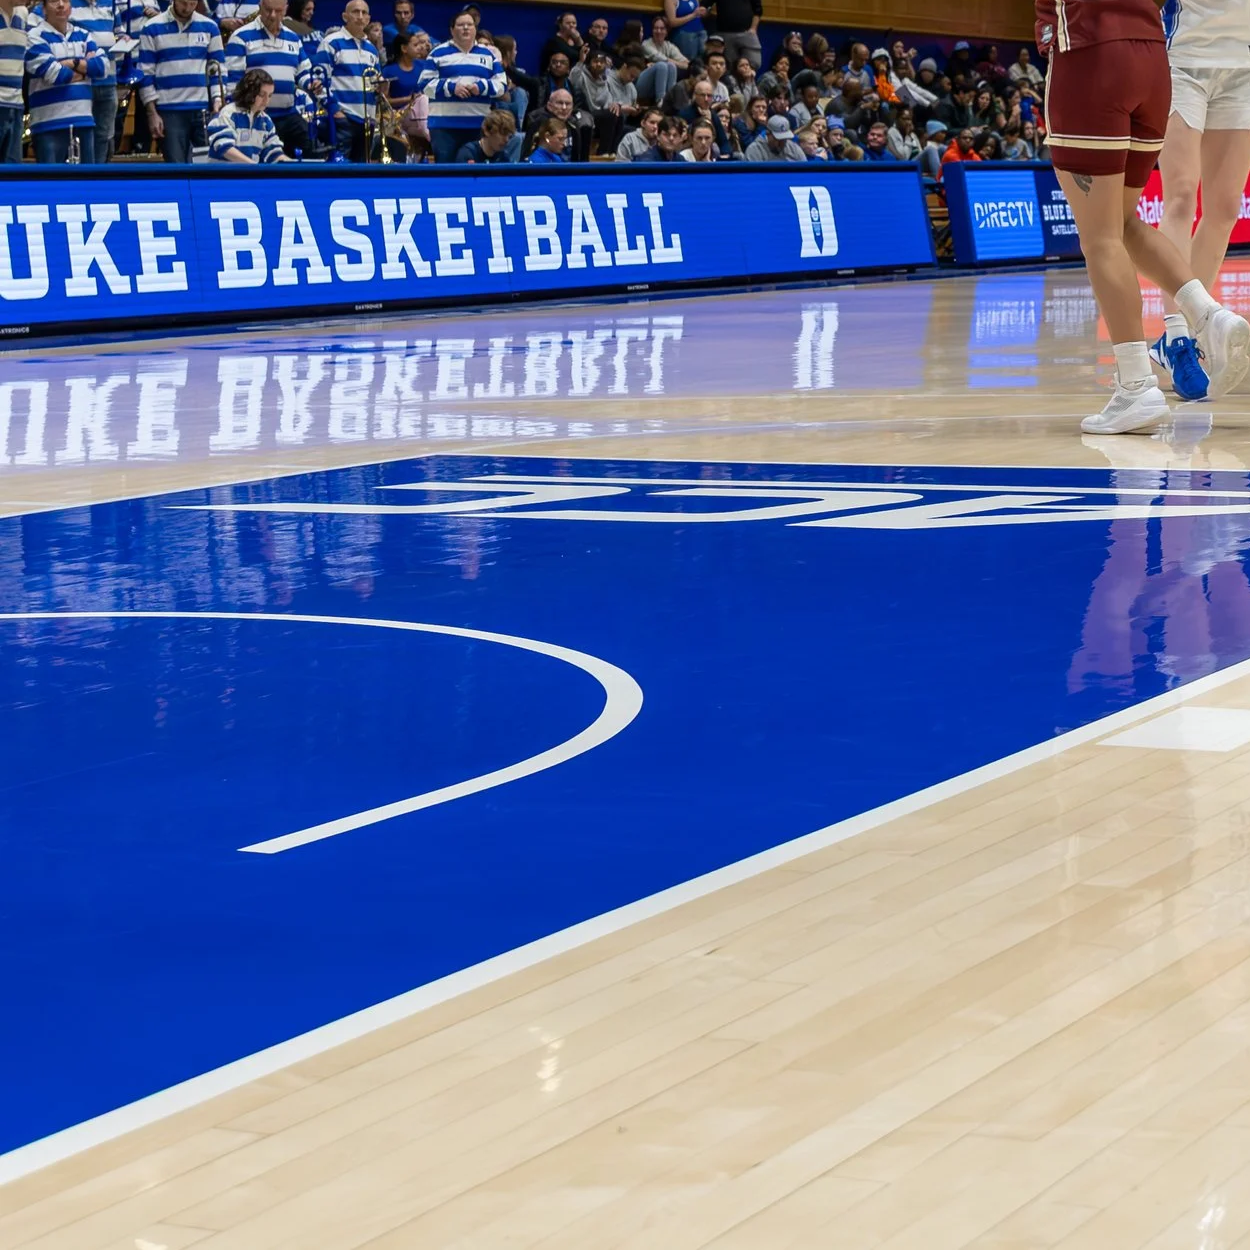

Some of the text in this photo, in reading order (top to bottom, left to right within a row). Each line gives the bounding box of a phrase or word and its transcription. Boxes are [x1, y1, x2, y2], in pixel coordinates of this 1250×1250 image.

[974, 200, 1034, 229] DIRECTV
[1042, 204, 1065, 221] BLUE
[209, 191, 685, 290] BASKETBALL
